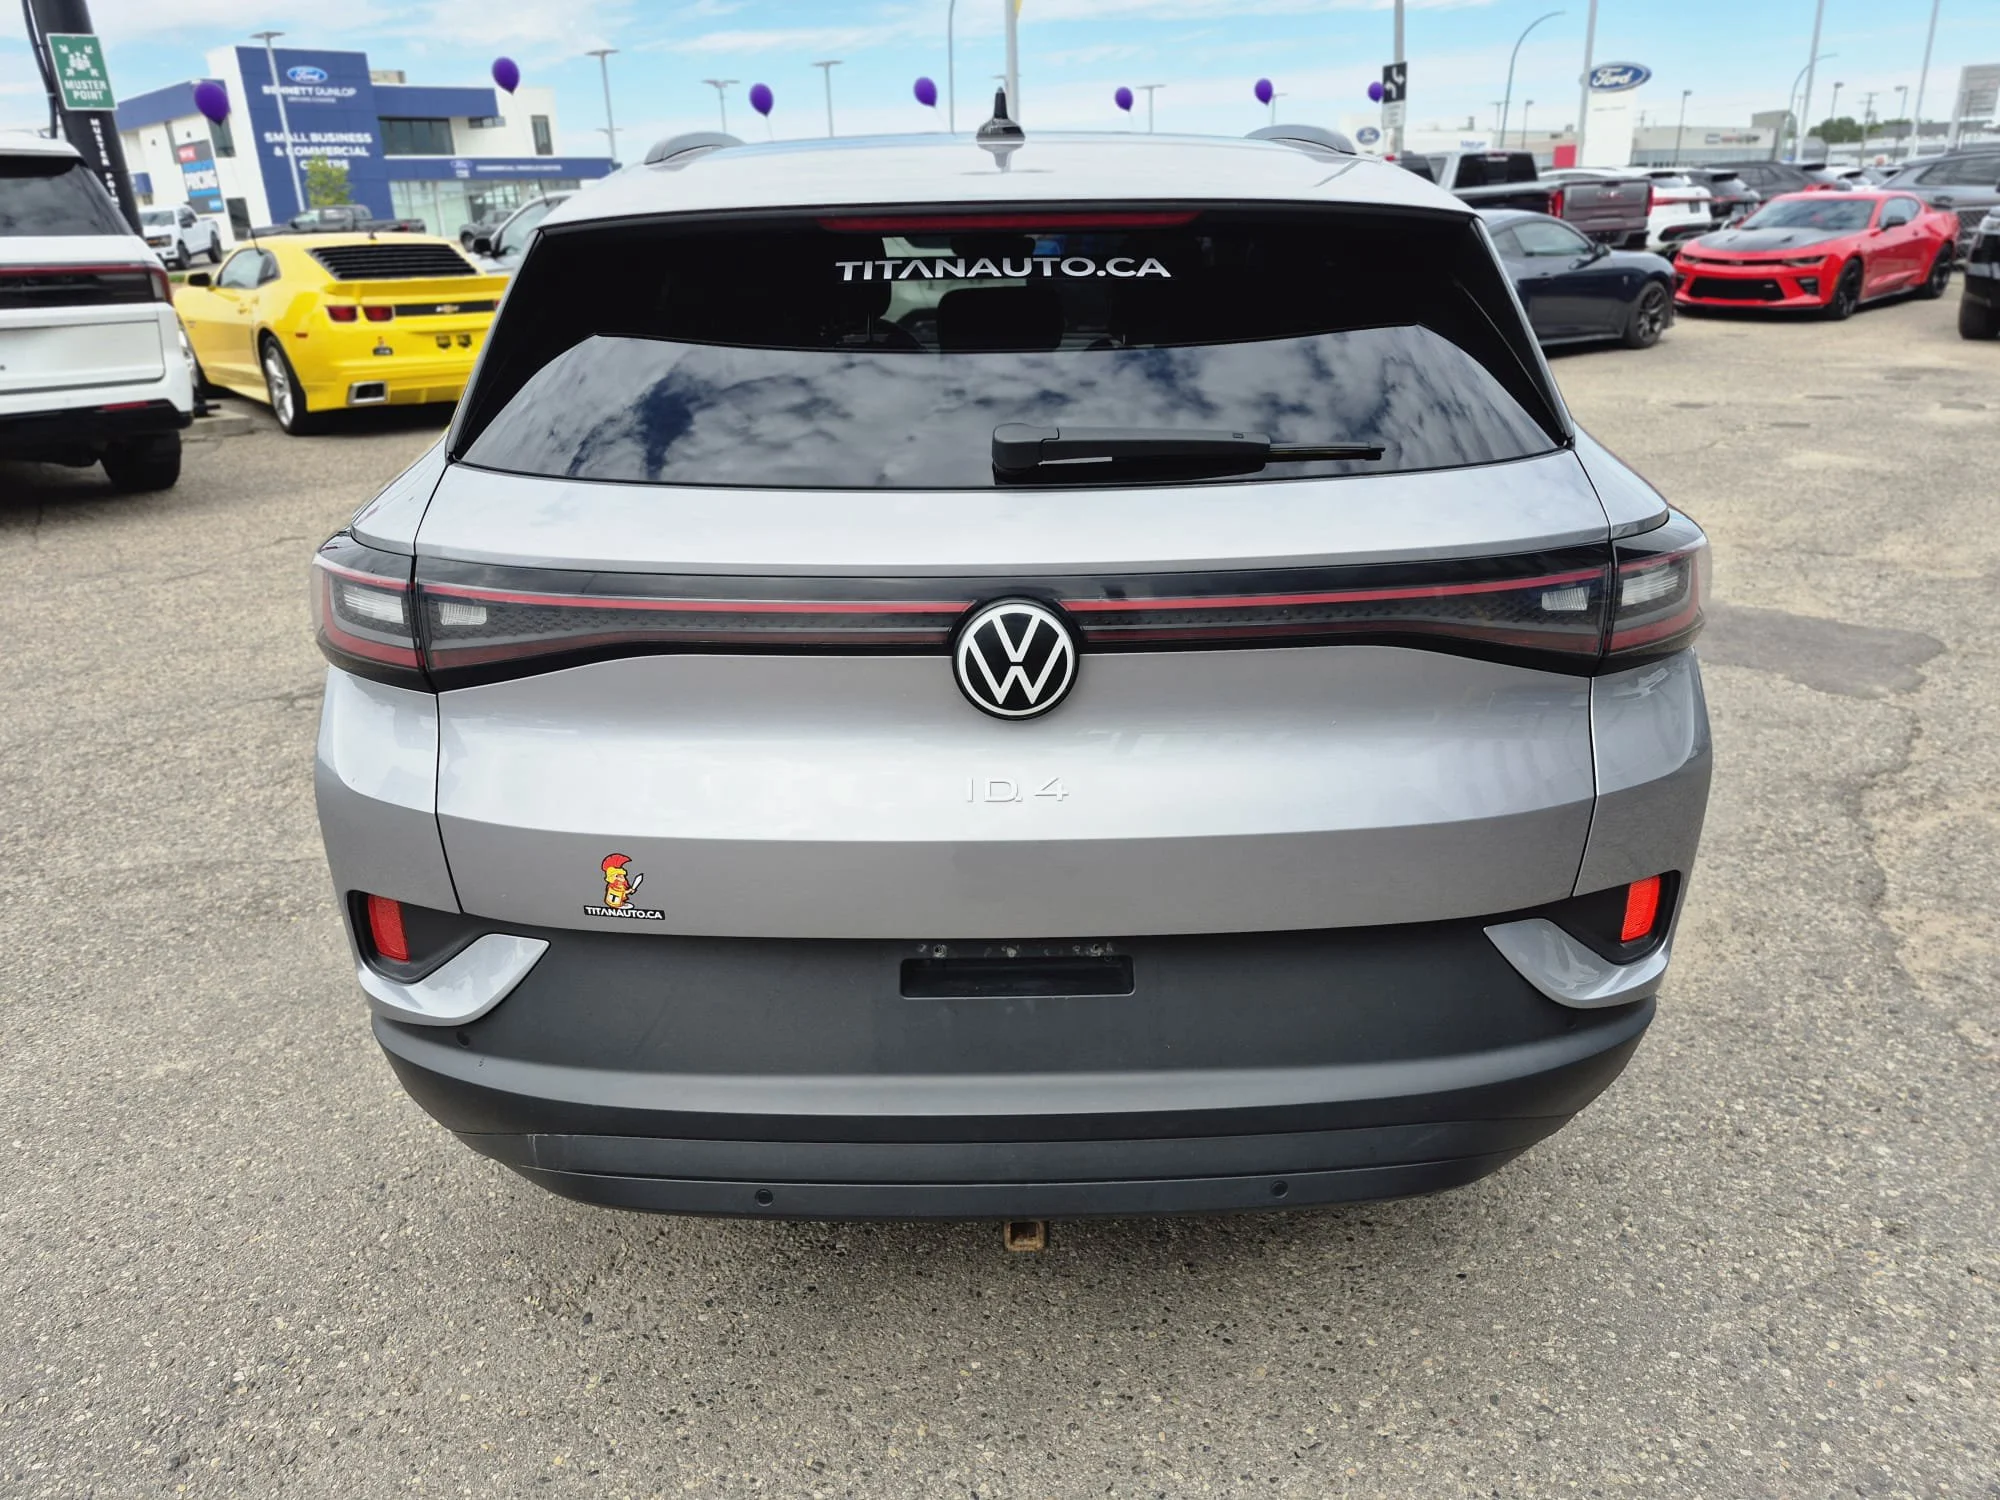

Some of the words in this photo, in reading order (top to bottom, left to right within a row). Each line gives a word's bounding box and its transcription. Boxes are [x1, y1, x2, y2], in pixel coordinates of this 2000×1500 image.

[1590, 67, 1636, 87] Ford
[64, 79, 107, 91] MUSTER
[73, 89, 104, 101] POINT
[310, 132, 373, 143] BUSINESS
[274, 146, 284, 156] &
[89, 117, 111, 167] MUSTER
[104, 171, 121, 208] POIN
[835, 257, 1171, 281] TITANAUTO.CA
[584, 906, 663, 920] TITANAUTO.CA
